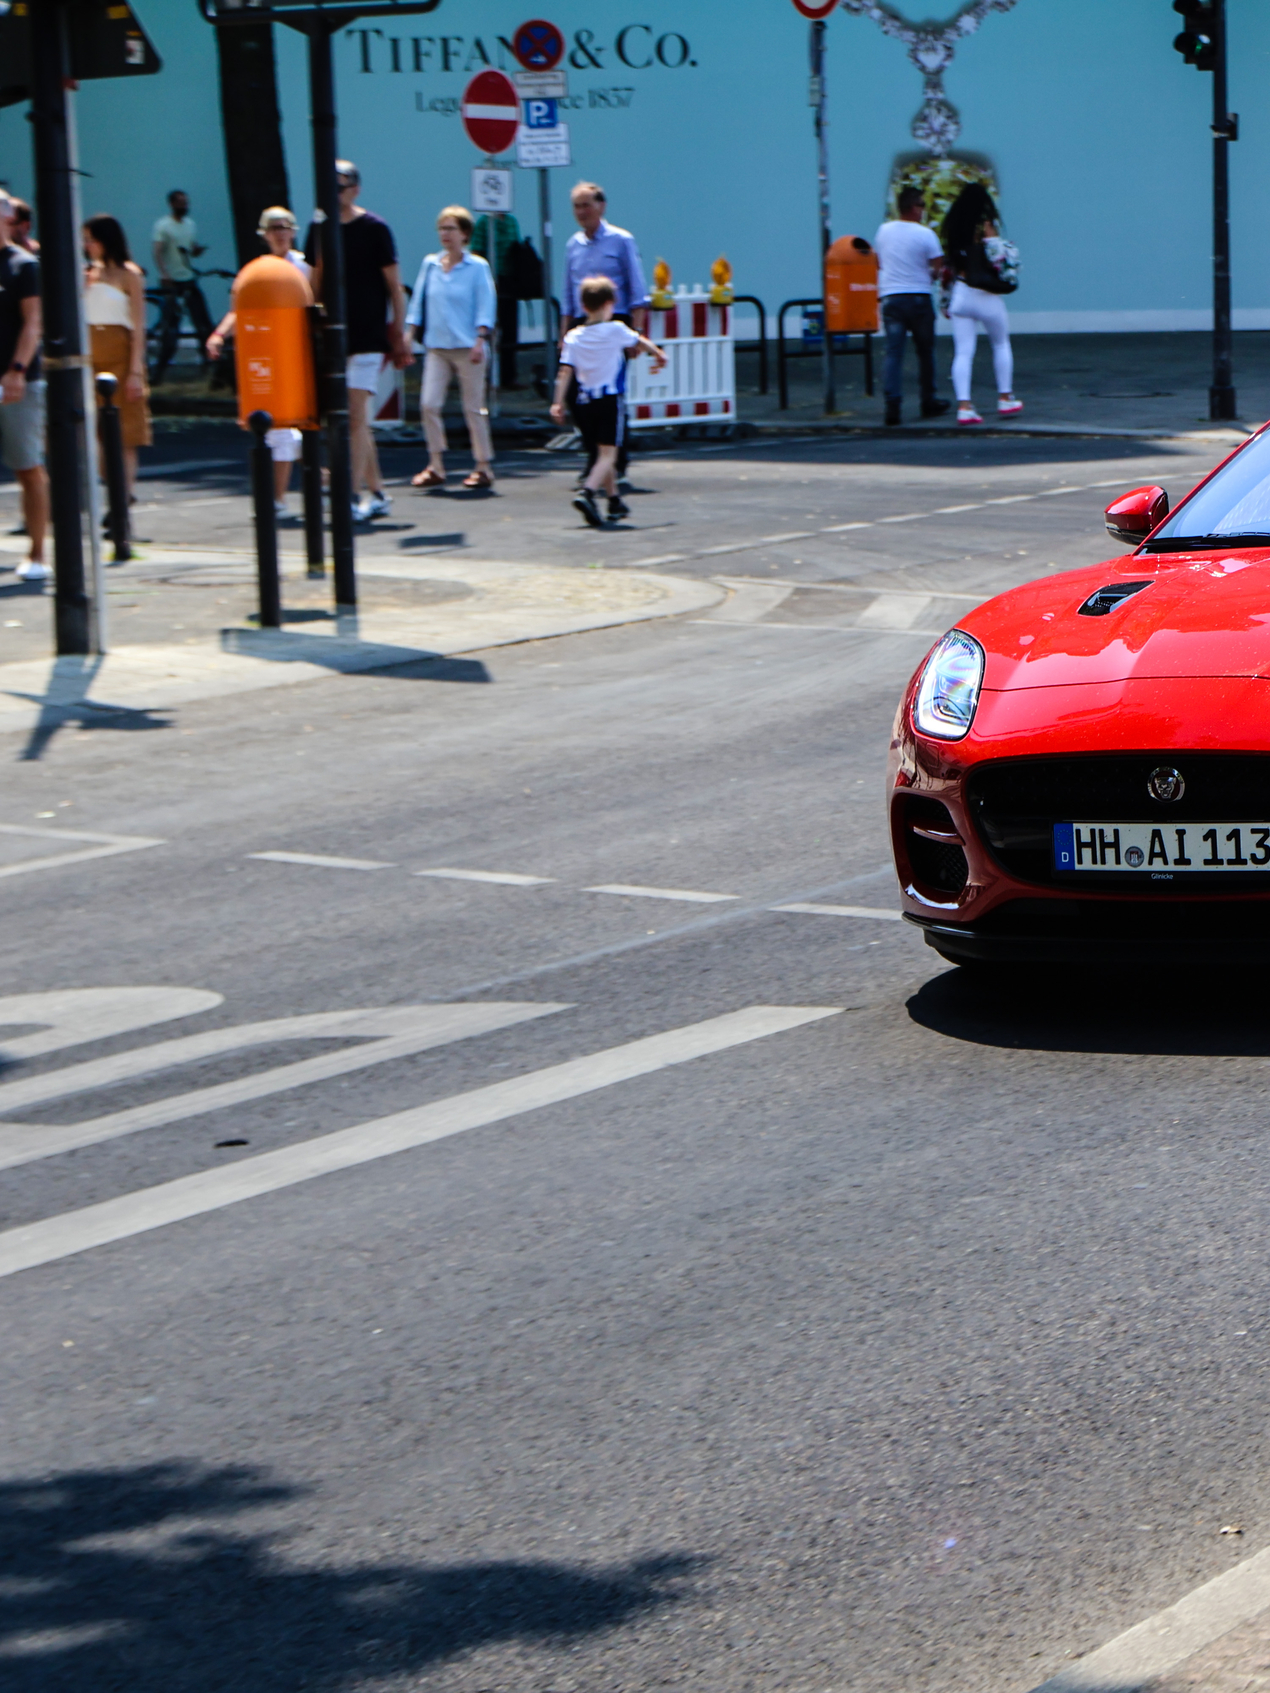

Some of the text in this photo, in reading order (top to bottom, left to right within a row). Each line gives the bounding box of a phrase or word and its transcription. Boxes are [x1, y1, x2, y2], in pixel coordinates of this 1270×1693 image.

[567, 28, 603, 70] &
[614, 24, 699, 70] Co.
[529, 101, 549, 126] P
[1061, 852, 1069, 863] D
[1075, 828, 1121, 866] HH
[1148, 828, 1192, 866] AI
[1151, 872, 1174, 881] Glinicke
